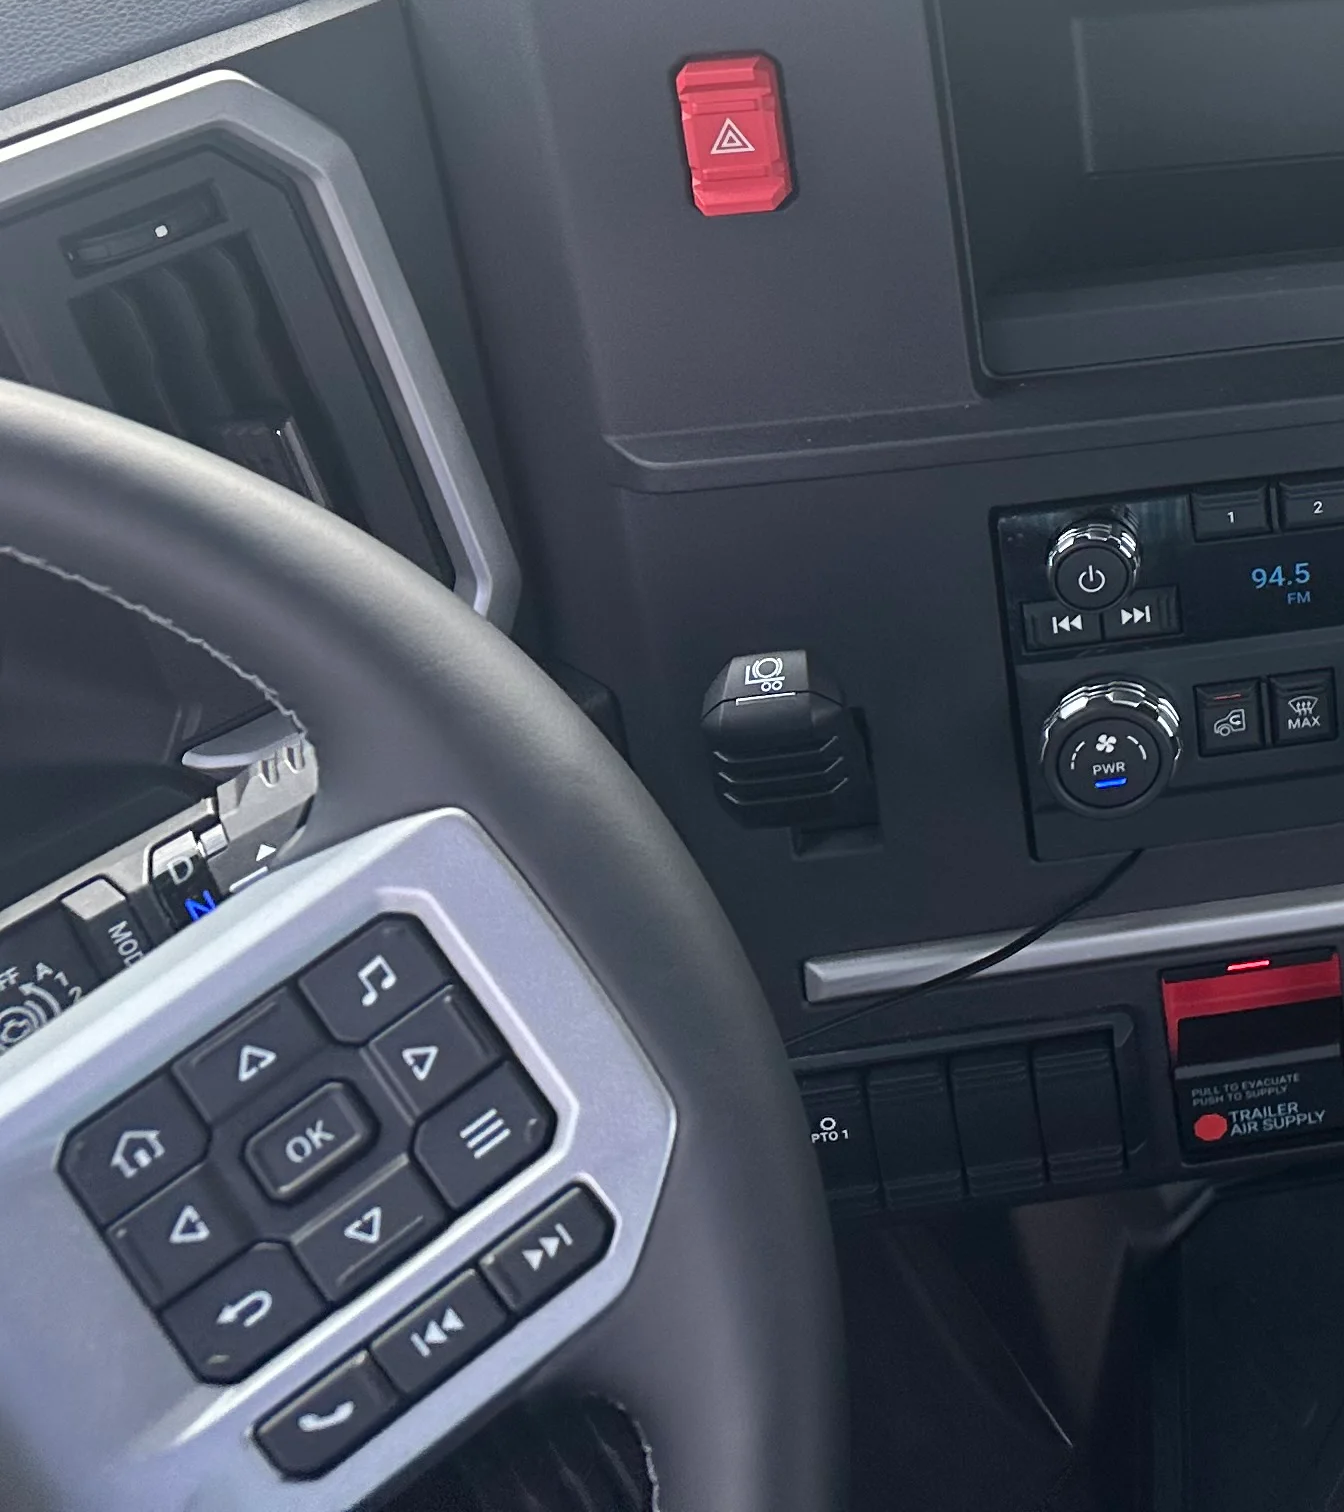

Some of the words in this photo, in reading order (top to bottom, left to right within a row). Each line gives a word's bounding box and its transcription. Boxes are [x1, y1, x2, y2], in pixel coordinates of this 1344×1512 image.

[1227, 511, 1235, 524] 1
[1313, 500, 1324, 514] 2
[1251, 562, 1311, 589] 94.5
[1287, 591, 1311, 605] FM
[1288, 716, 1321, 730] MAX
[1092, 761, 1126, 776] PWR
[167, 856, 194, 885] D
[184, 890, 216, 922] N
[1192, 1085, 1220, 1098] PULL
[1224, 1082, 1239, 1093] TO
[1242, 1073, 1300, 1090] EVACUATE
[1192, 1096, 1224, 1107] PUSH
[1228, 1092, 1242, 1102] TO
[1245, 1084, 1288, 1099] SUPPLY
[1228, 1102, 1299, 1123] TRAILER
[1230, 1122, 1258, 1137] AIR
[1262, 1110, 1326, 1131] SUPPLY
[285, 1120, 336, 1164] OK
[811, 1131, 839, 1144] PTO
[842, 1129, 849, 1140] 1
